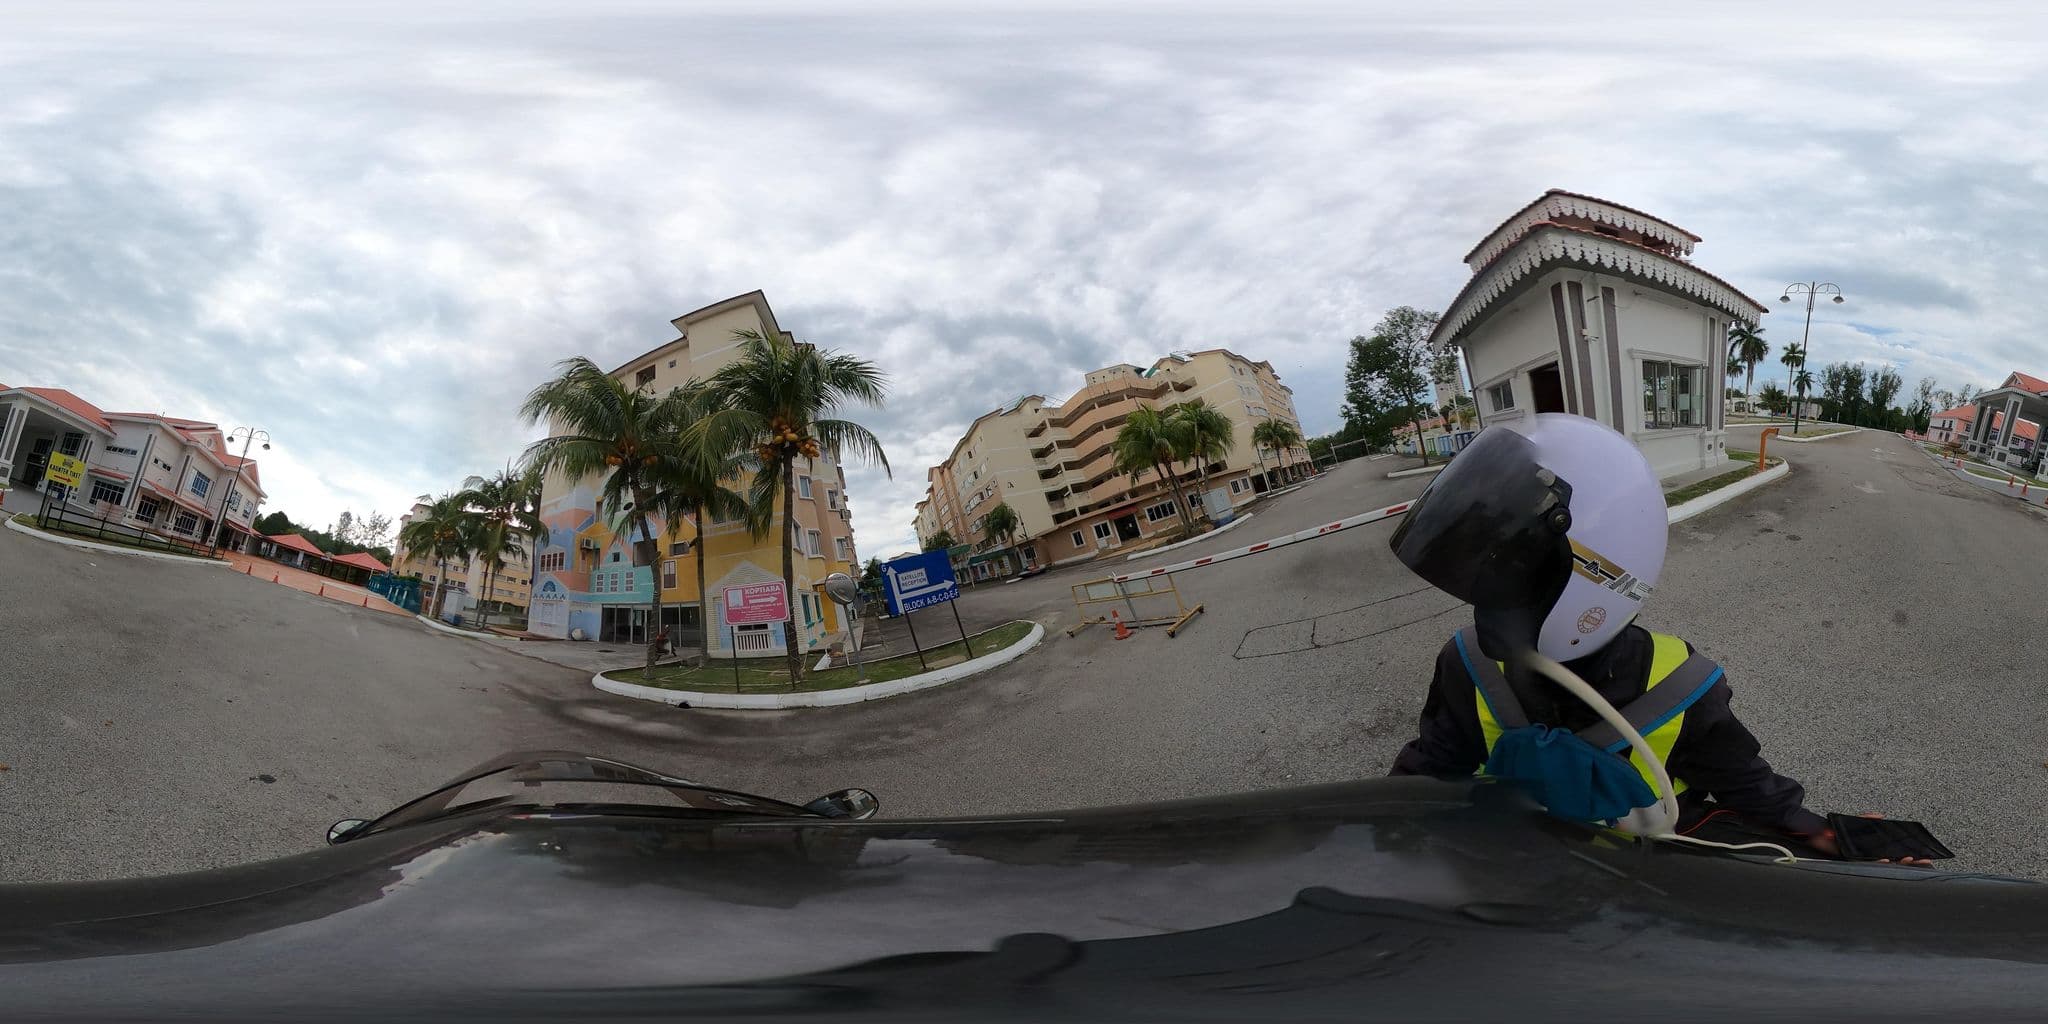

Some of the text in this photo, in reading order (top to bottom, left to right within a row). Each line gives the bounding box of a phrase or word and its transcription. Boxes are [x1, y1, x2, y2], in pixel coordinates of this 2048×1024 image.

[881, 564, 887, 573] G
[901, 578, 927, 588] RECEPTION
[904, 598, 926, 611] BLOCK
